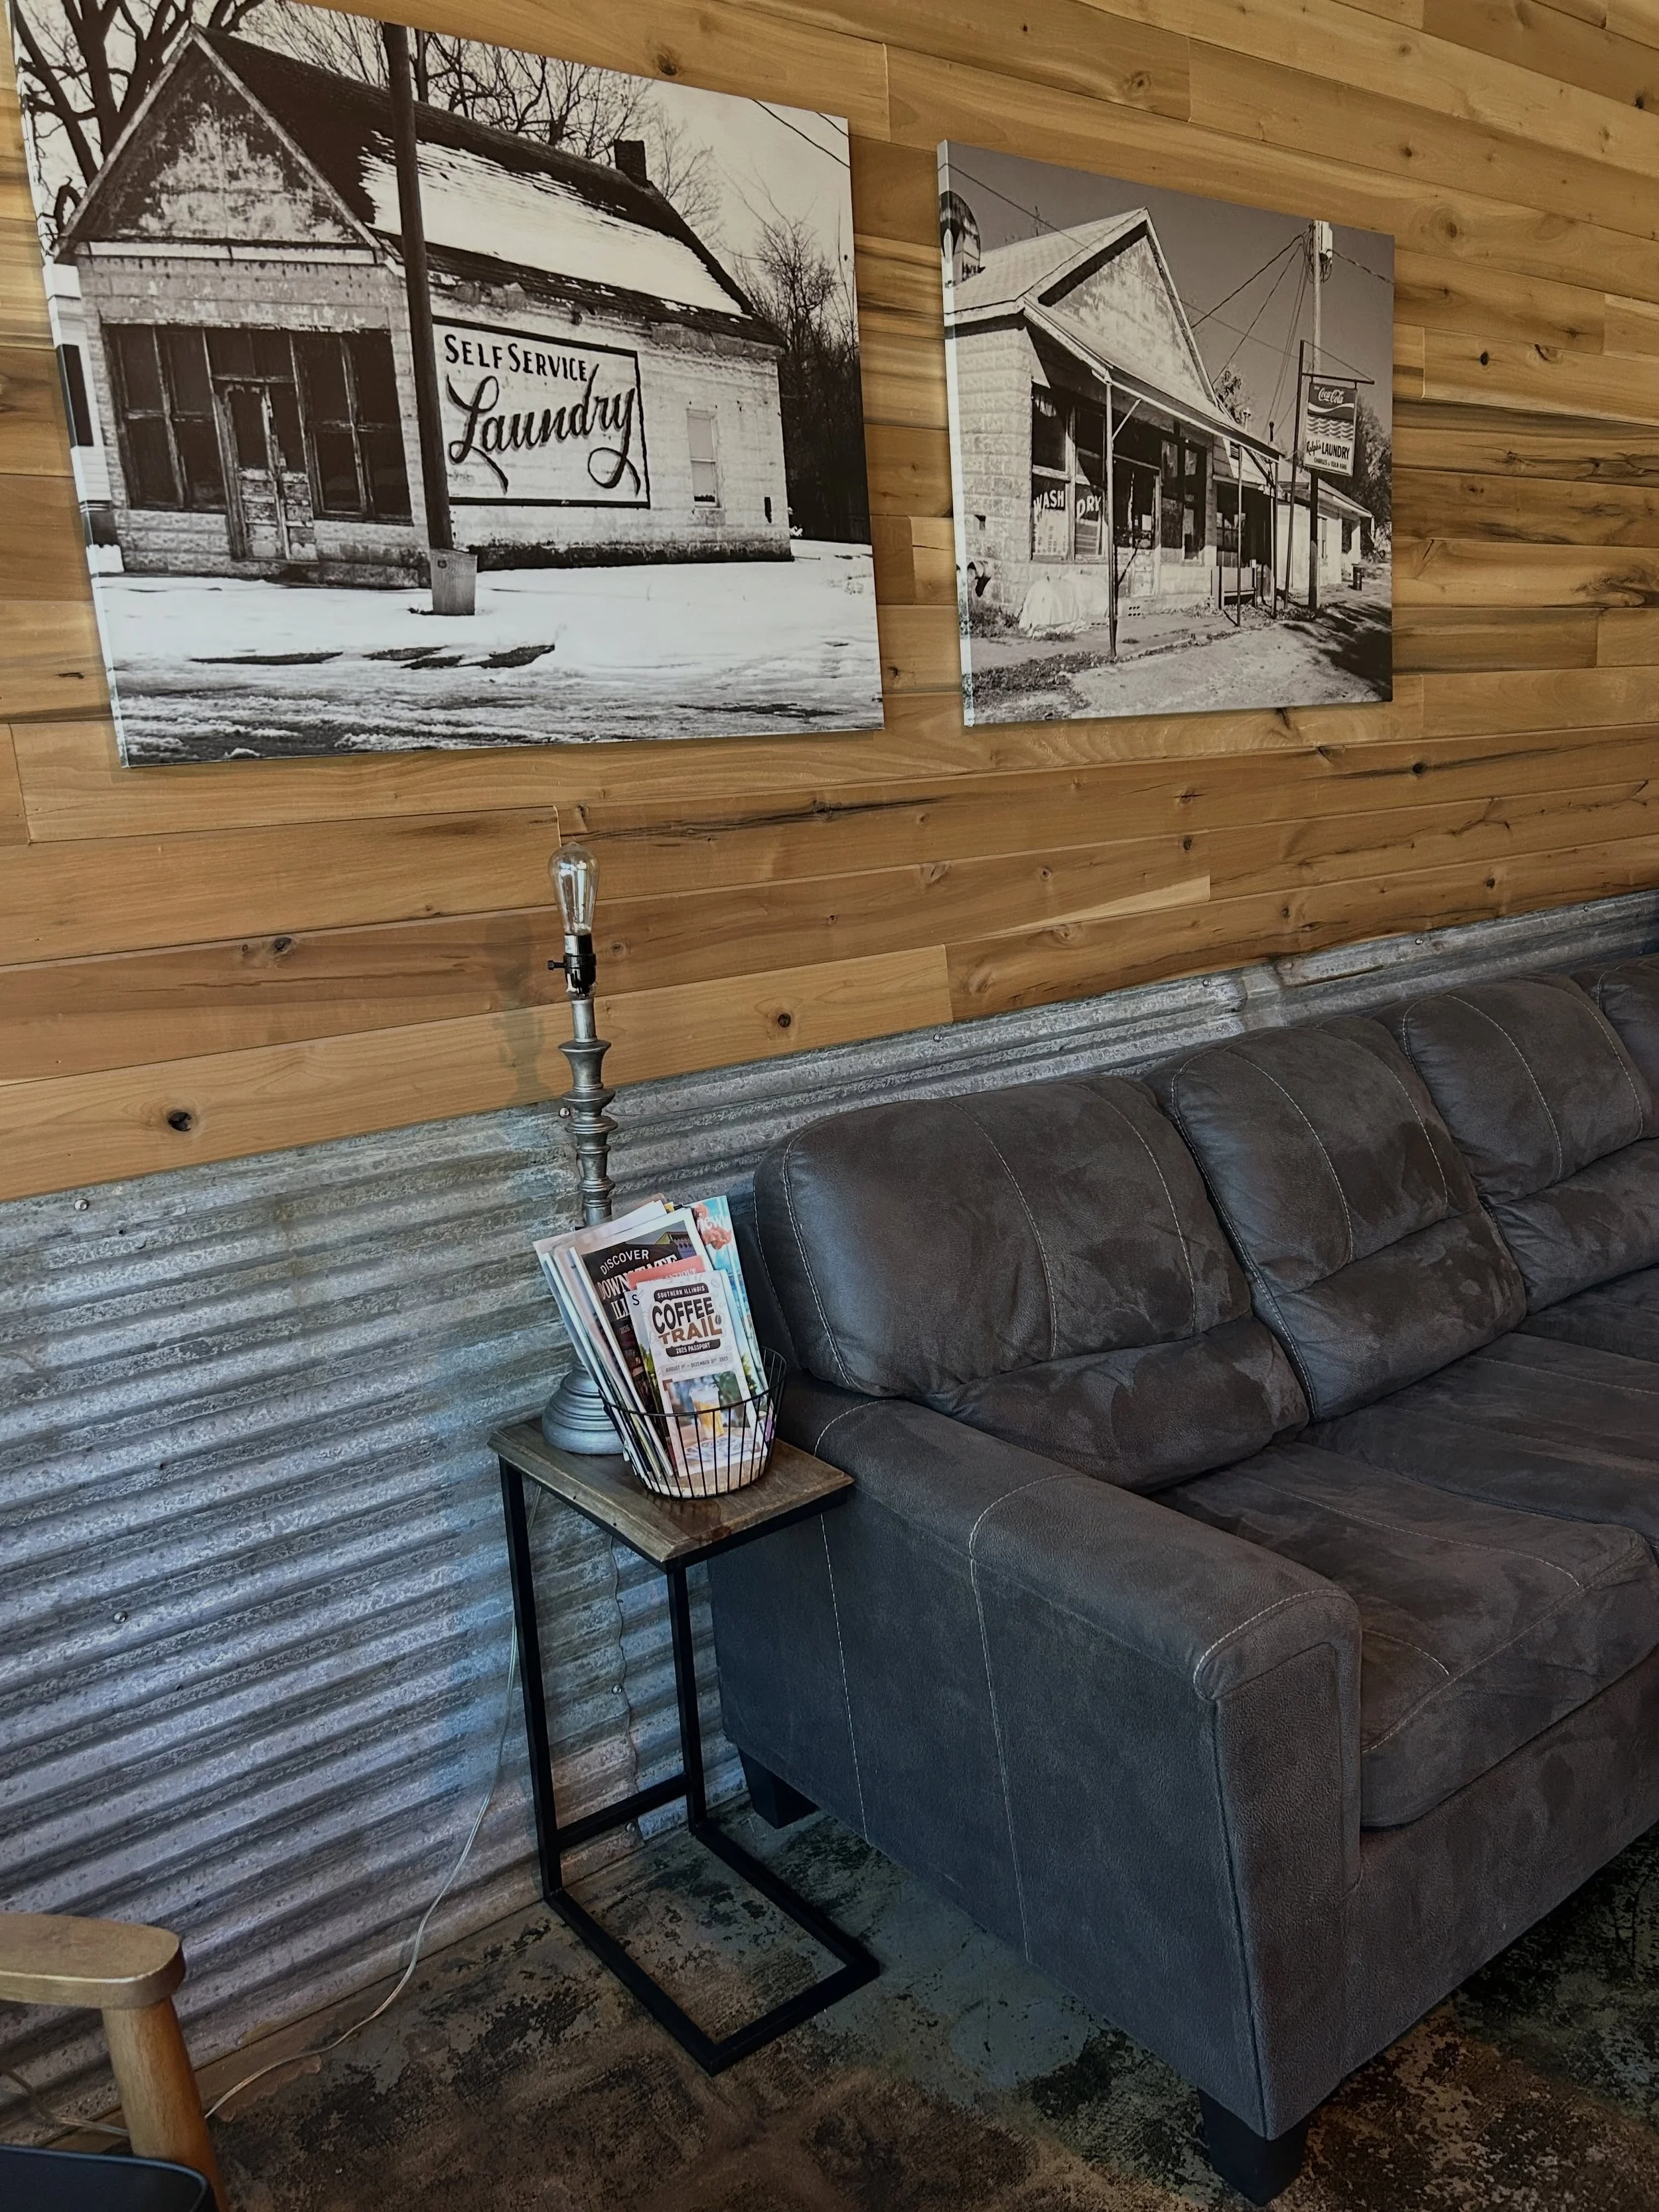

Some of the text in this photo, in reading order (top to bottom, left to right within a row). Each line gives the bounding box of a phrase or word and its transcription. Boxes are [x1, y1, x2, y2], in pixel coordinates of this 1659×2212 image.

[445, 334, 587, 382] SELF SERVICE
[446, 364, 642, 498] Laundry
[1322, 442, 1350, 461] LAUNDRY
[1033, 490, 1064, 517] WASH
[1076, 495, 1102, 518] DRY
[600, 1249, 649, 1275] DISCOVER
[657, 1286, 705, 1299] SOUTHERN ILLINOIS
[652, 1297, 715, 1334] COFFEE
[658, 1315, 723, 1345] TRAIL
[688, 1342, 711, 1352] PASSPORT
